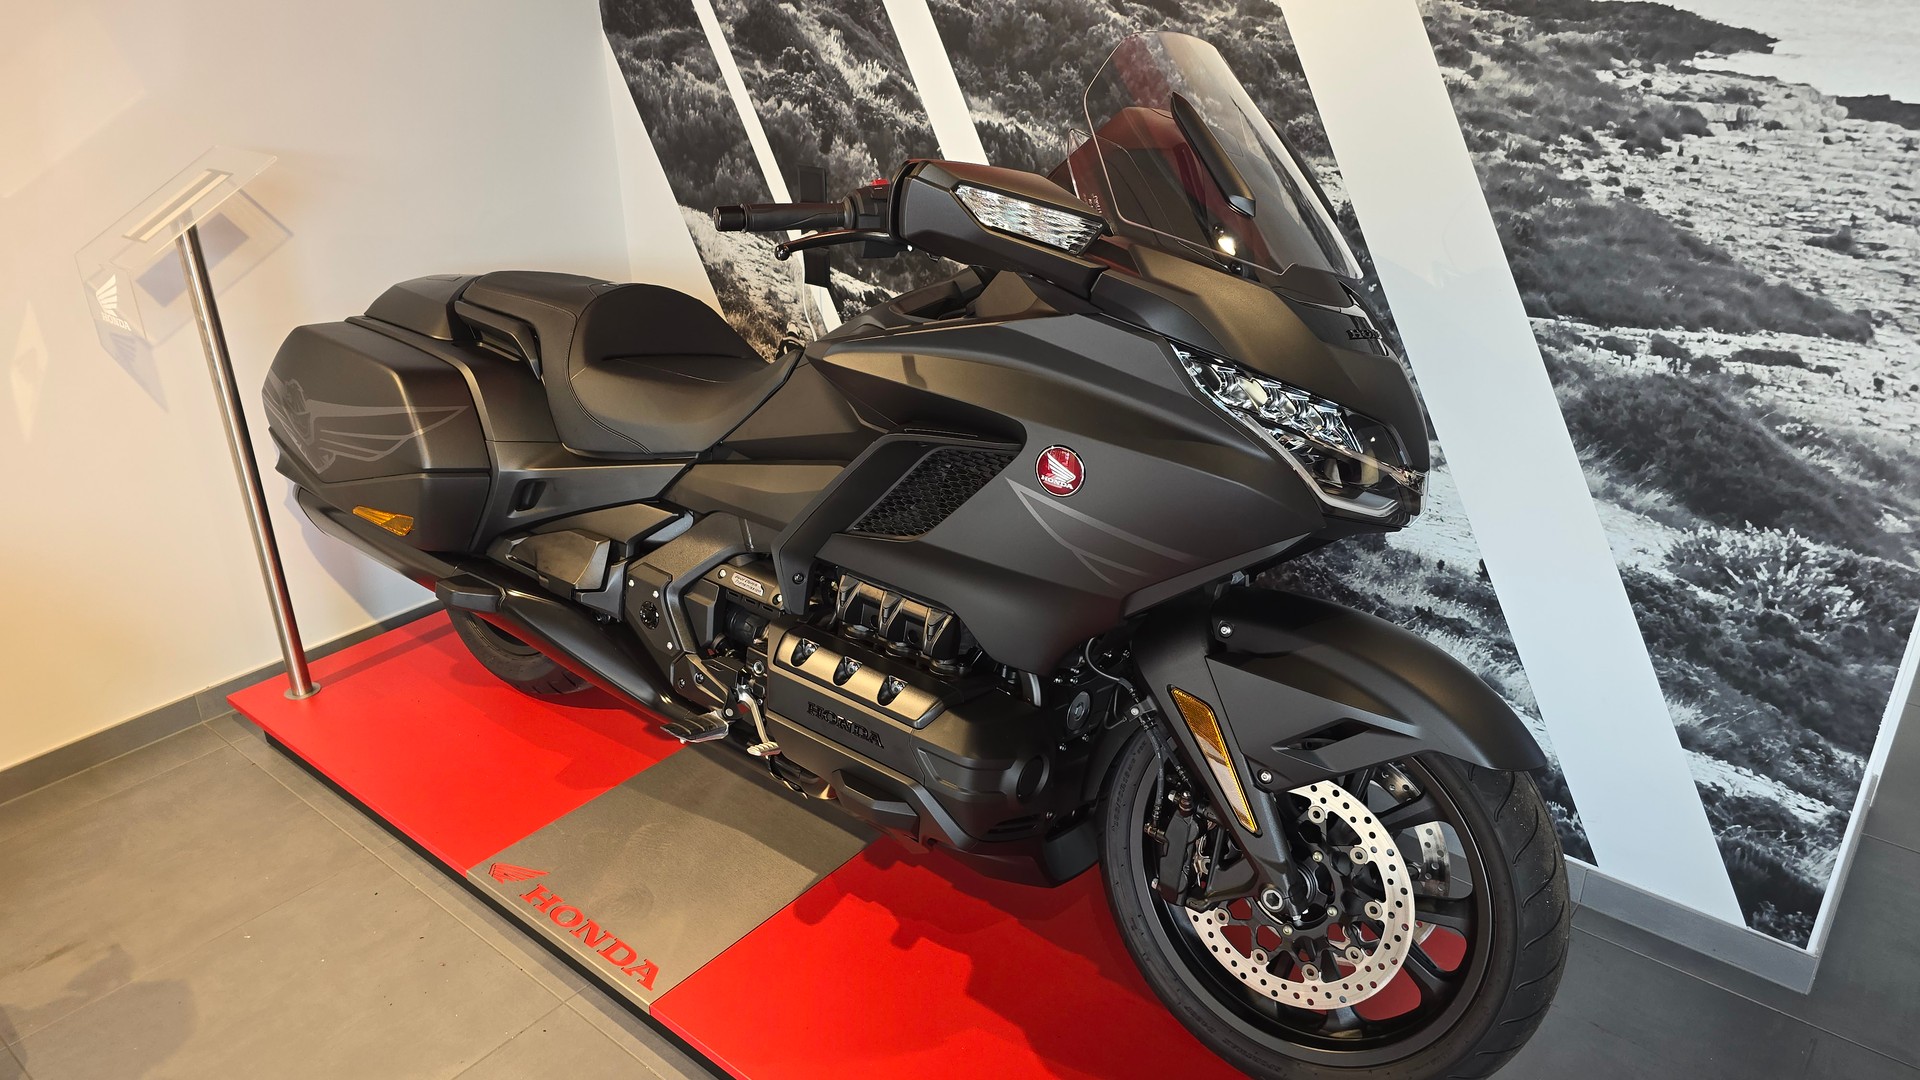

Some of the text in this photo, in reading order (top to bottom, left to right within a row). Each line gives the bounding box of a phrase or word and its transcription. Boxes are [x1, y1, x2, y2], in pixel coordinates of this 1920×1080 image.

[102, 311, 131, 331] HONDA
[1041, 475, 1074, 489] HONDA
[805, 701, 884, 749] HONDA
[519, 883, 660, 991] HONDA
